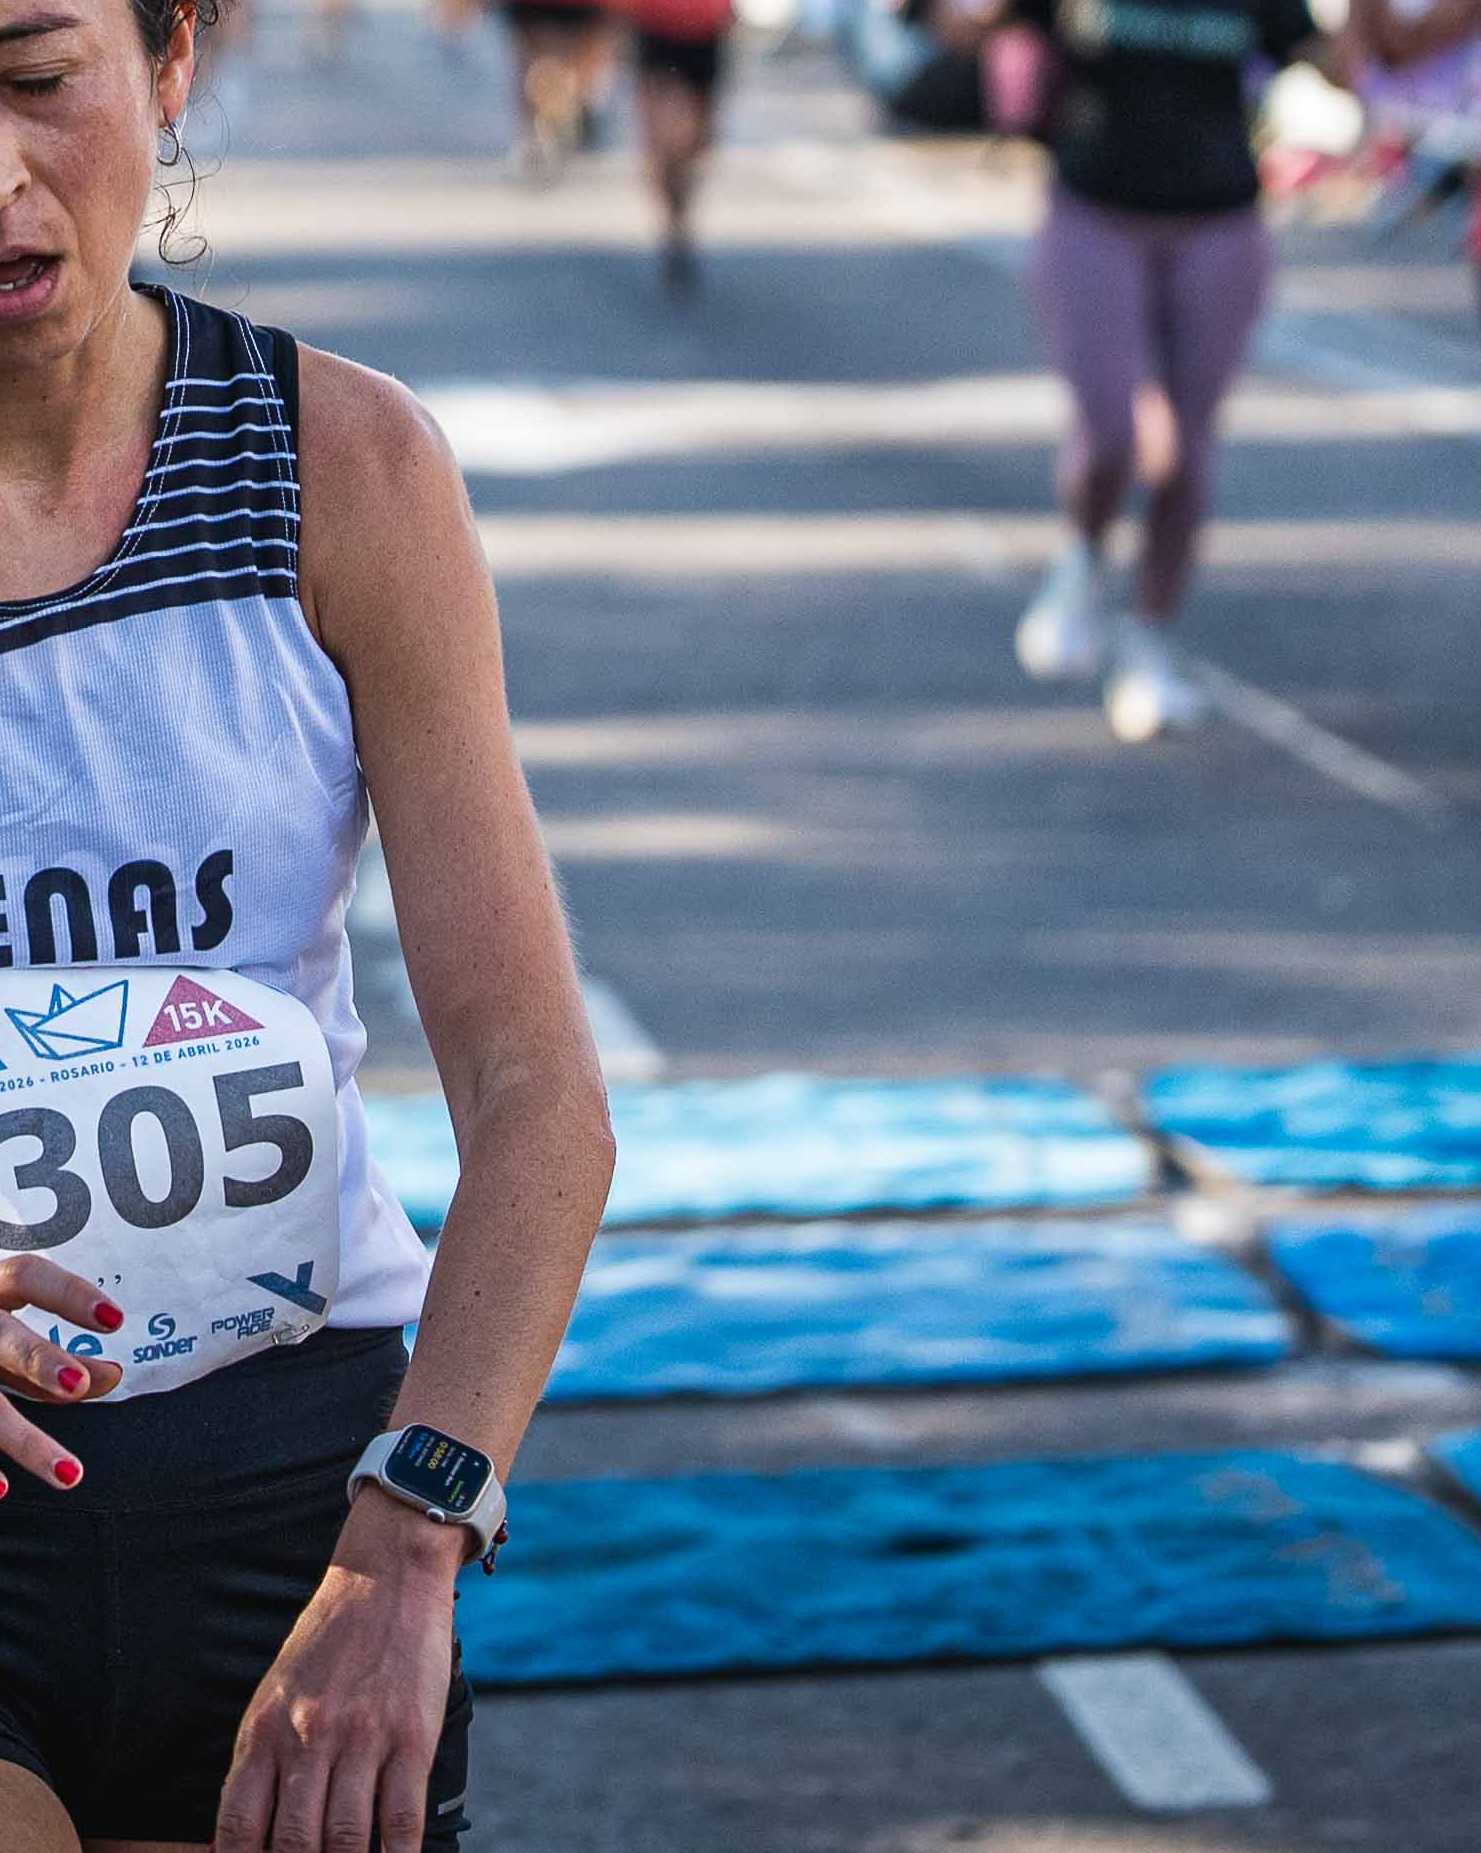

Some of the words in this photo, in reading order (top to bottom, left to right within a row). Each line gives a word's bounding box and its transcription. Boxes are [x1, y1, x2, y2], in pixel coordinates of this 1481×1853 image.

[163, 999, 233, 1032] 15K
[0, 1076, 34, 1093] 2026
[50, 1060, 115, 1084] ROSARIO
[132, 1055, 149, 1067] 12
[154, 1050, 173, 1064] DE
[178, 1044, 221, 1060] ABRIL
[225, 1035, 261, 1051] 2026
[211, 1306, 275, 1334] POWER
[237, 1320, 274, 1340] ADE
